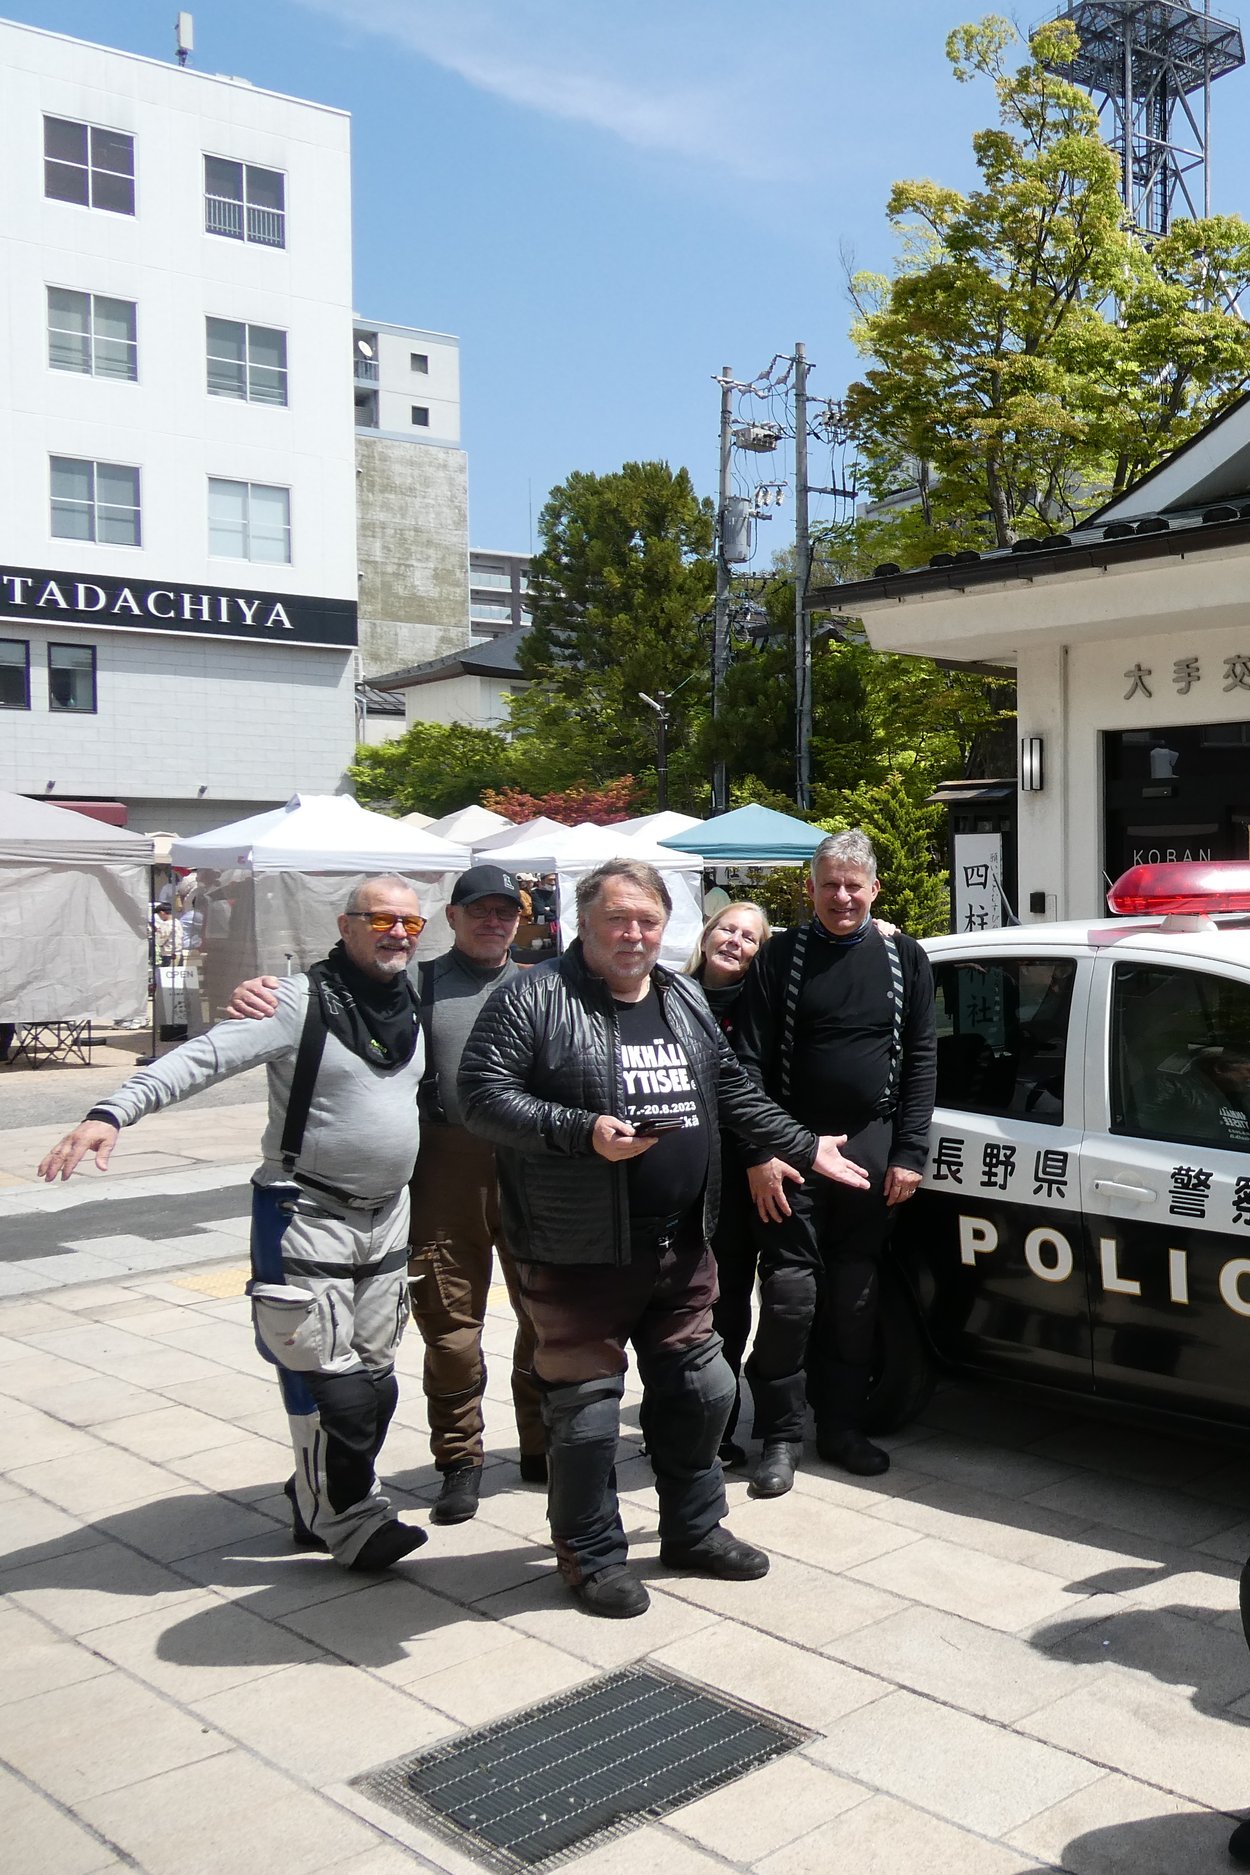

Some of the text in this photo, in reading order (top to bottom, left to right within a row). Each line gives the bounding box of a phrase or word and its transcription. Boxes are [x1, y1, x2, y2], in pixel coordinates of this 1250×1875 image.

[3, 576, 294, 629] TADACHIYA
[1133, 848, 1211, 866] KOBAN
[963, 863, 990, 932] 四柱
[622, 1068, 690, 1094] YTISEE
[932, 1137, 1069, 1199] 長野県
